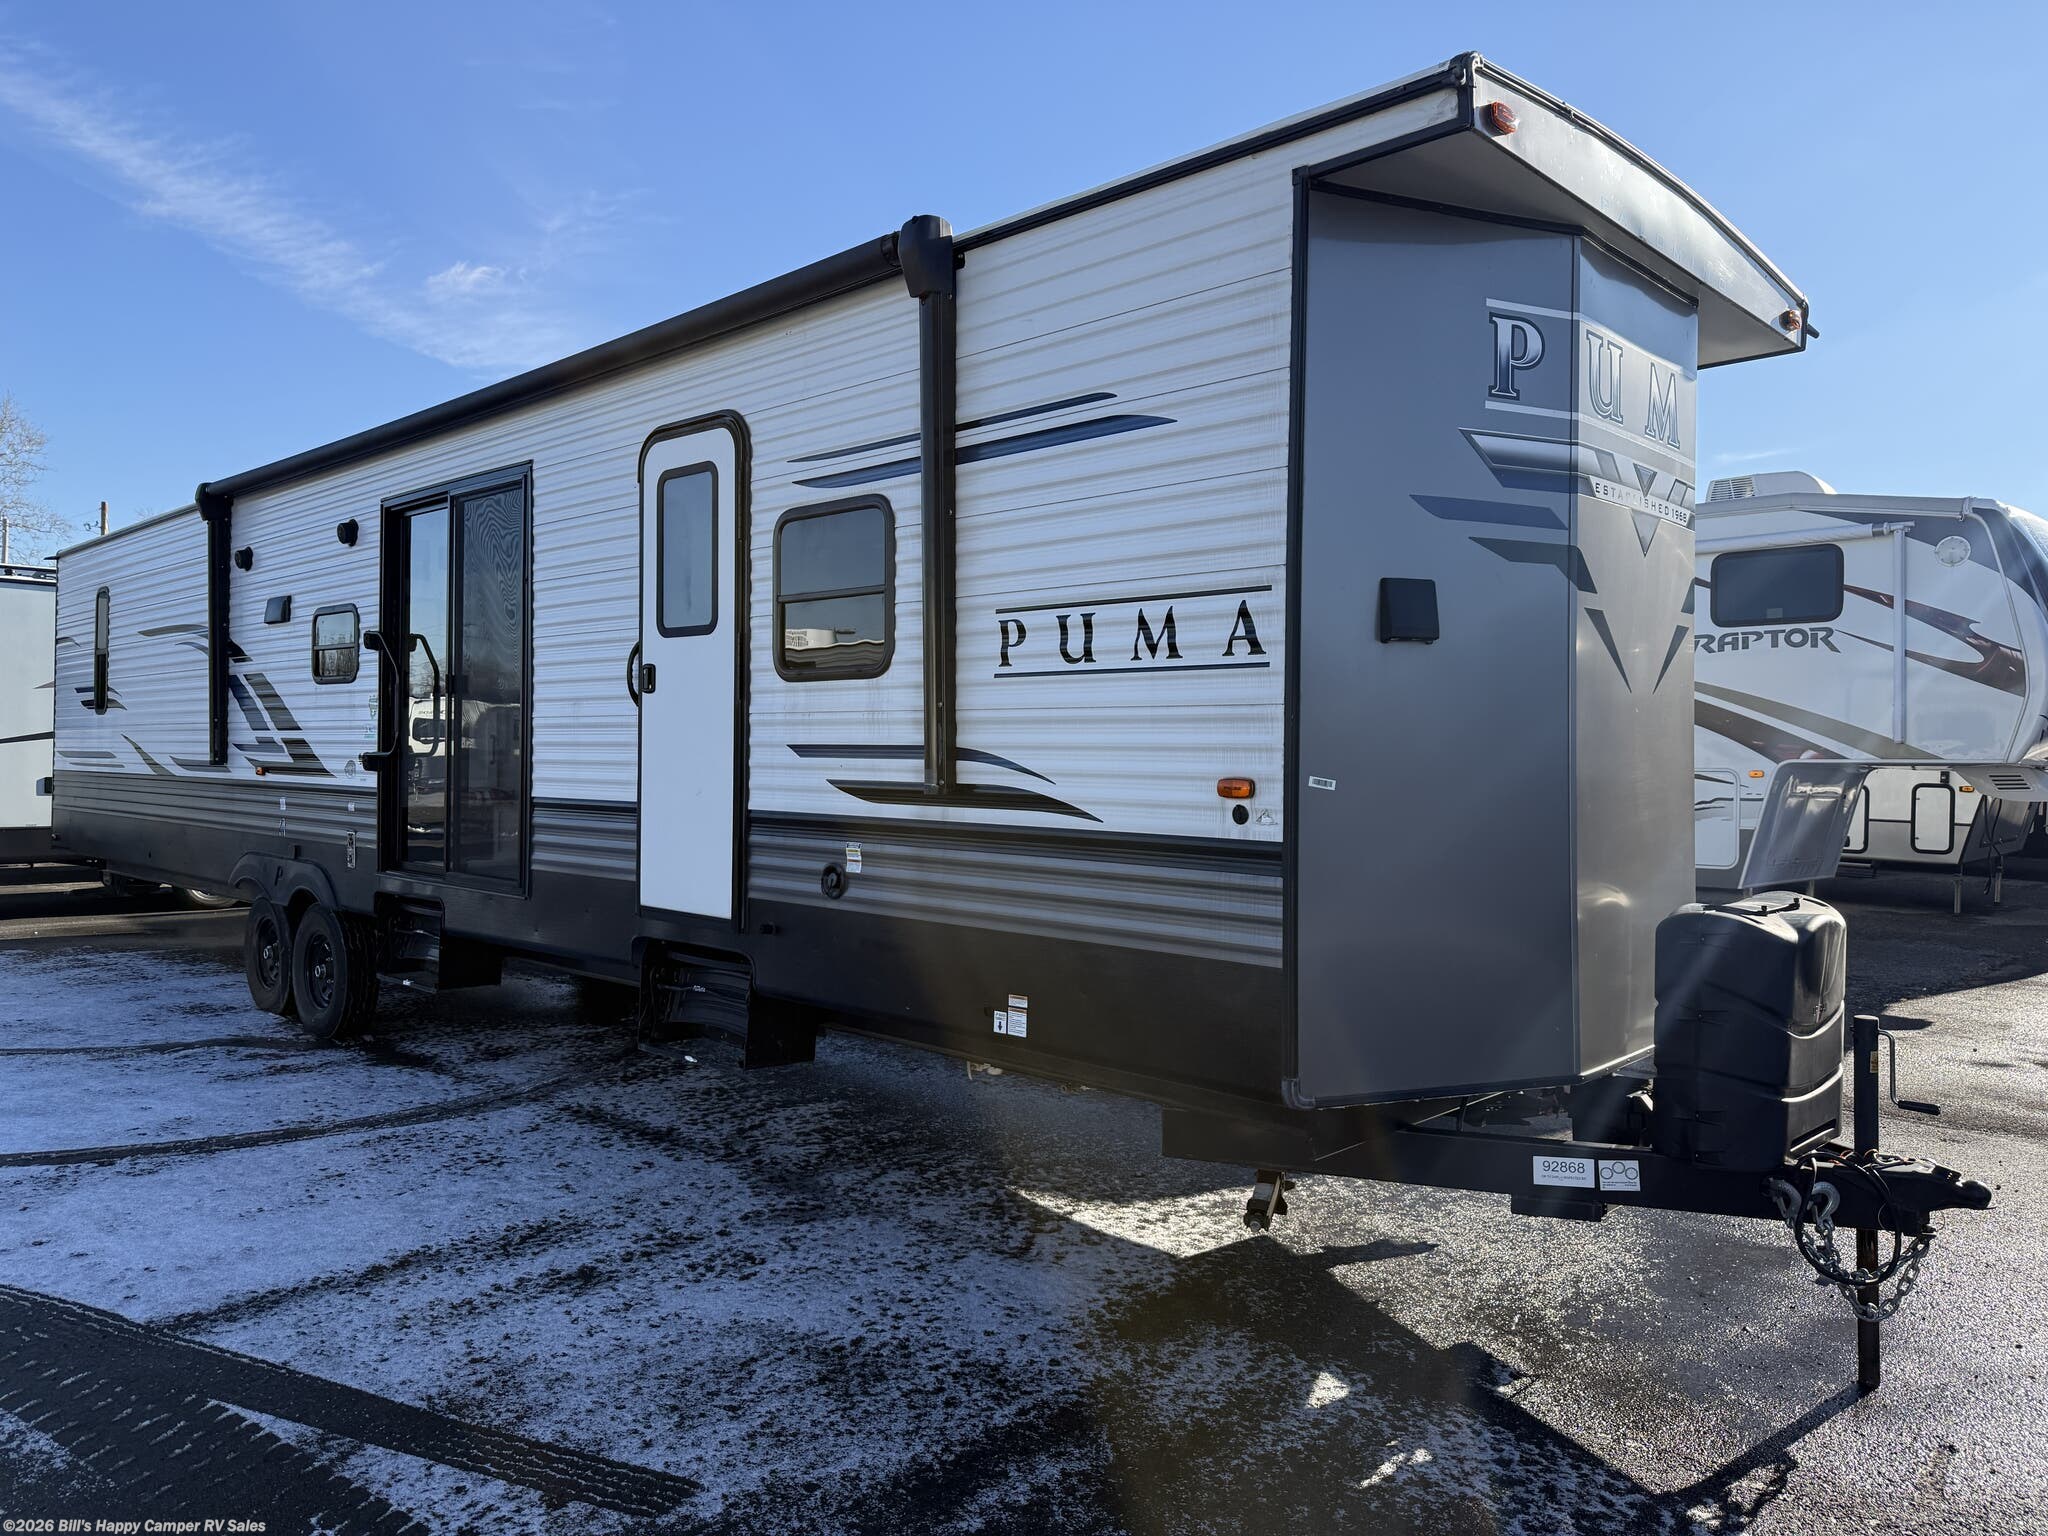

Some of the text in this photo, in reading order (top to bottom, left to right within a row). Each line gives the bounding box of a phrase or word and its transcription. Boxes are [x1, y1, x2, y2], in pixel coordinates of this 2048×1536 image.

[1595, 482, 1669, 515] ESTAISHED
[998, 600, 1266, 667] PUMA
[1694, 627, 1841, 654] RAPTOR
[1542, 1160, 1586, 1174] 92868
